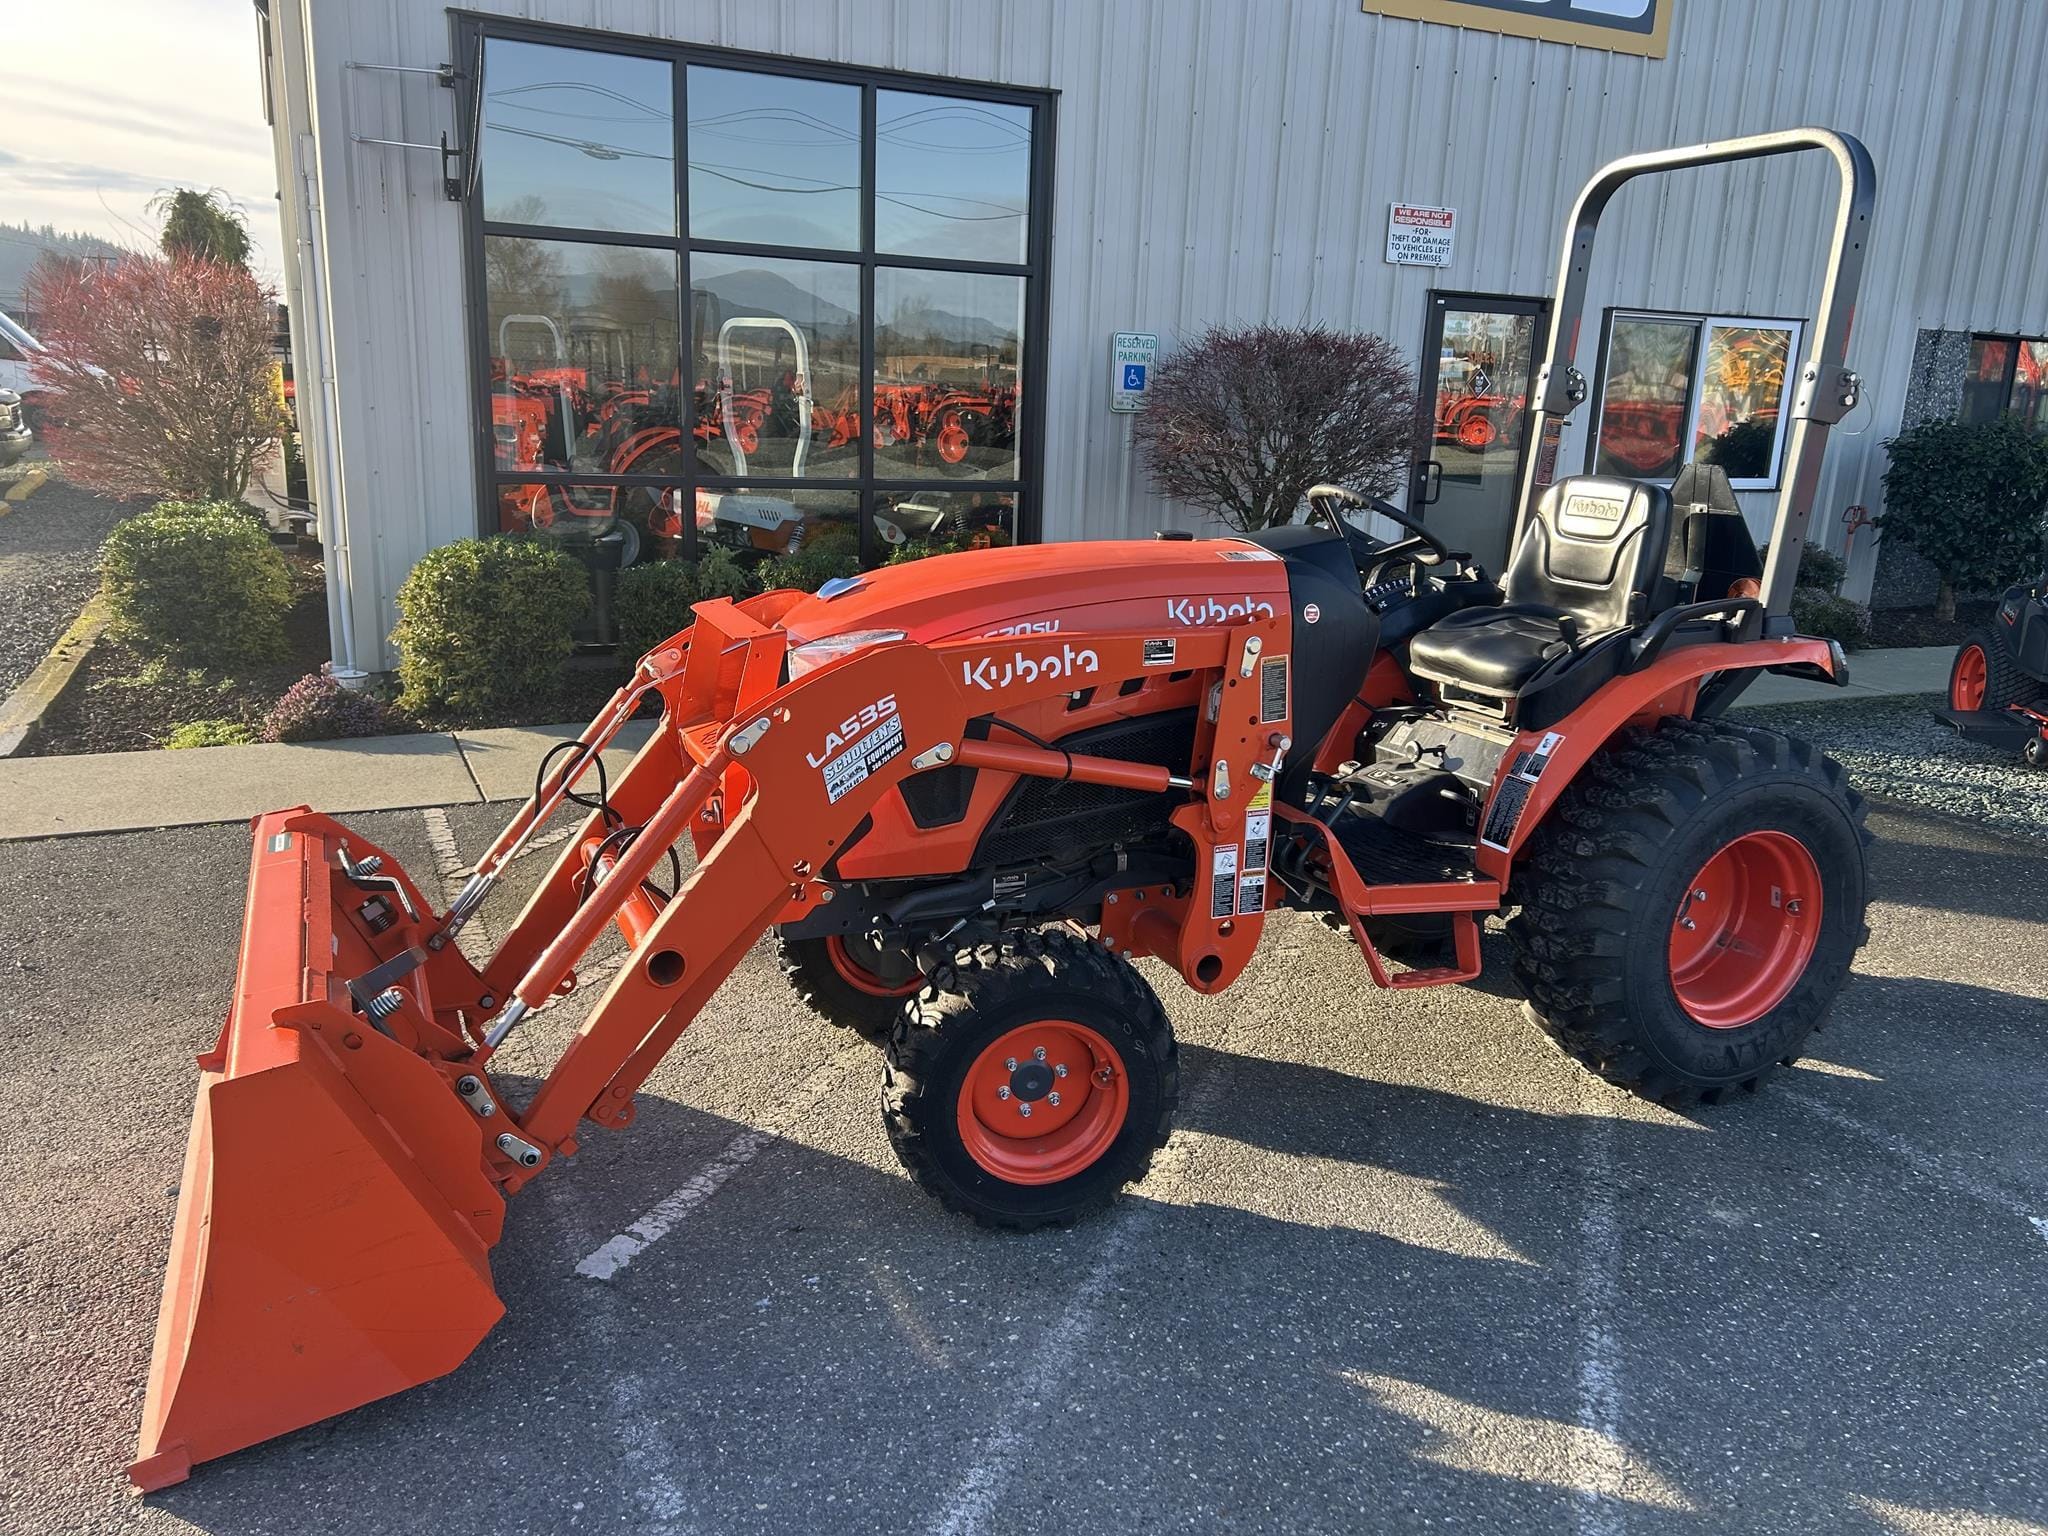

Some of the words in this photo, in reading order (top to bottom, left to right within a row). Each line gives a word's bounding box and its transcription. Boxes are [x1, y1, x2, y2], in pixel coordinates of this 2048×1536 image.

[1394, 216, 1450, 227] RESPONSIBLE
[1392, 234, 1410, 242] THEFT
[1422, 237, 1450, 246] DAMAGE
[1402, 244, 1432, 253] VEHICLES
[1410, 253, 1442, 262] PREMISES
[1117, 337, 1156, 350] RESERVED
[1118, 351, 1152, 363] PARKING
[1571, 499, 1619, 518] Kubota
[1167, 596, 1274, 625] Kubota
[962, 643, 1099, 691] Kubota
[805, 693, 897, 769] LA535
[824, 716, 900, 781] SCHOLTEN'S
[866, 731, 903, 766] EQUIPMENT
